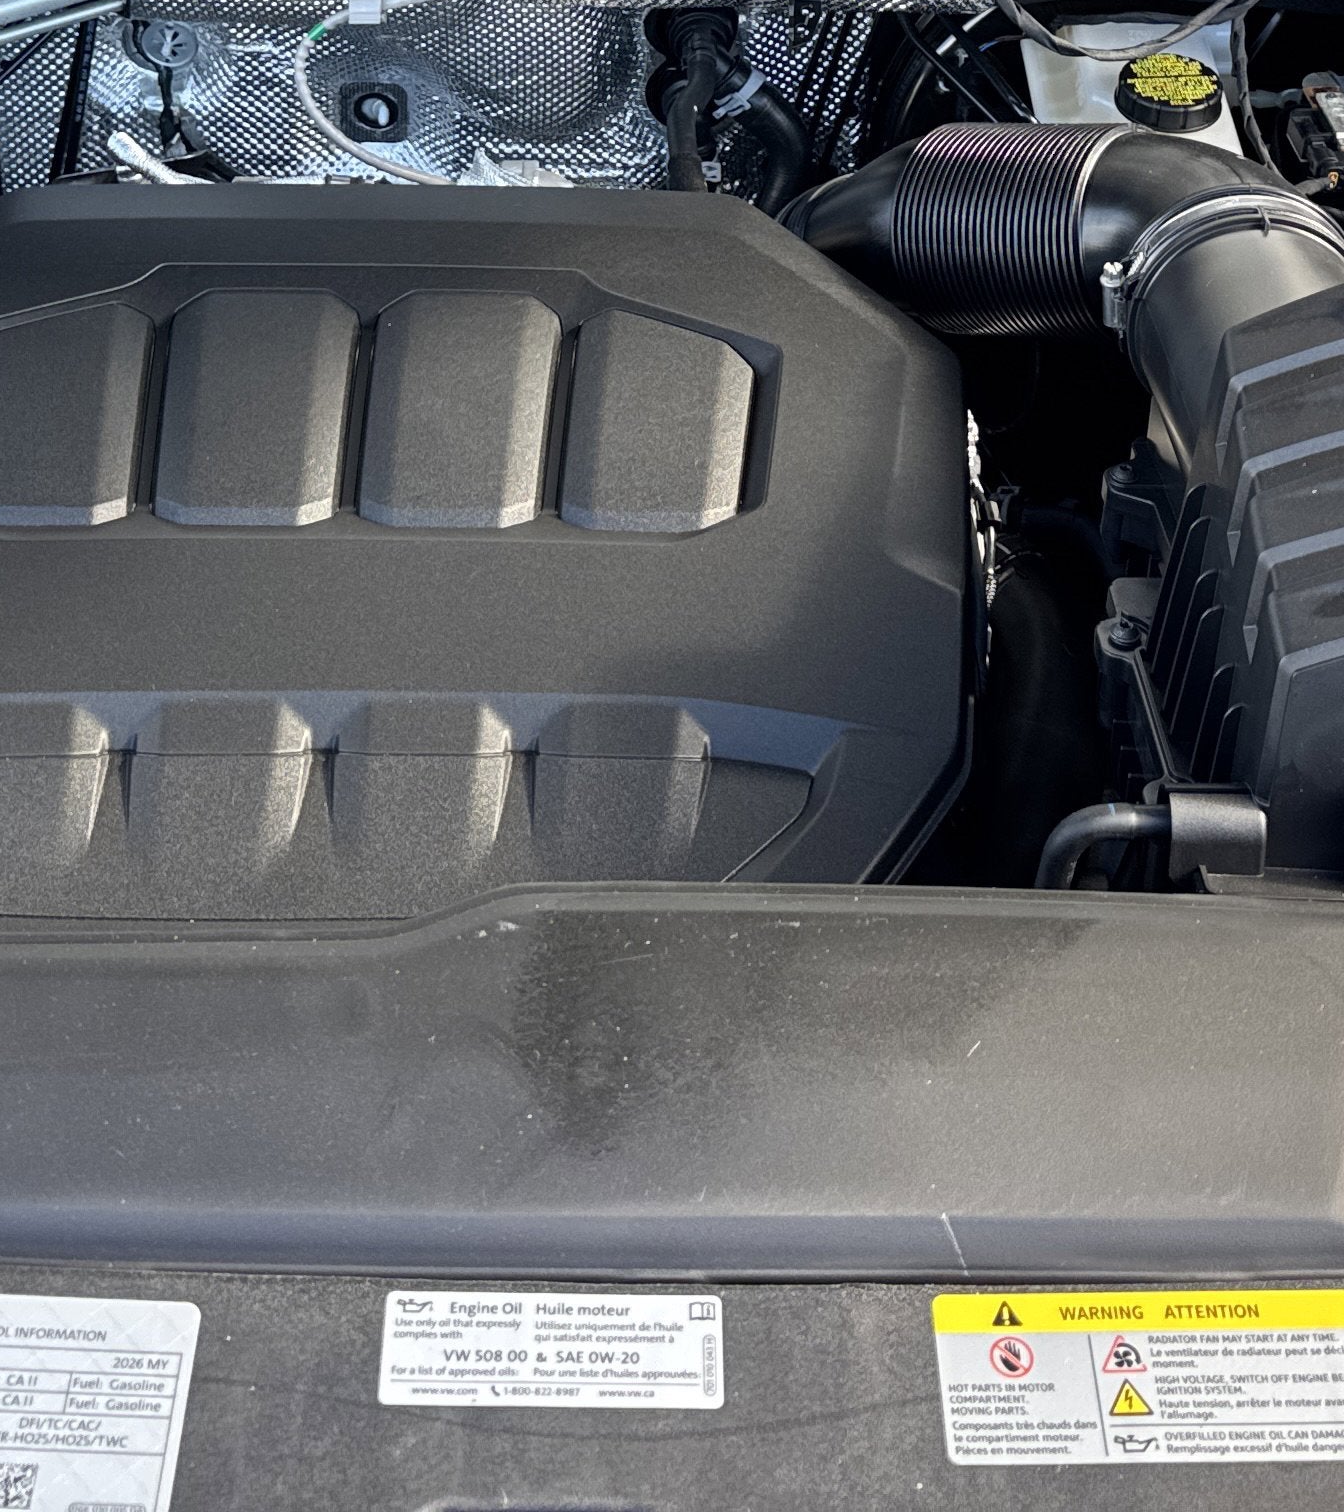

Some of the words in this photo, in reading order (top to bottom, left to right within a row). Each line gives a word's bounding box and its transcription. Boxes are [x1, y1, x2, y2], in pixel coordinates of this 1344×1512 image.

[450, 1301, 498, 1317] Engine
[502, 1302, 522, 1314] Oil
[535, 1303, 573, 1315] Huile
[577, 1304, 630, 1316] moteur
[1059, 1305, 1143, 1320] WARNING
[1164, 1304, 1260, 1319] ATTENTION
[395, 1318, 413, 1327] Use
[416, 1318, 436, 1329] only
[439, 1318, 451, 1327] oil
[453, 1319, 473, 1328] that
[475, 1319, 522, 1331] expressly
[535, 1320, 572, 1330] Utilisez
[574, 1321, 636, 1332] uniquement
[638, 1322, 651, 1331] de
[653, 1322, 684, 1332] l'huile
[15, 1327, 107, 1342] INFORMATION
[393, 1330, 438, 1341] complies
[440, 1330, 463, 1339] with
[534, 1333, 551, 1343] qui
[553, 1333, 593, 1342] satisfait
[595, 1333, 665, 1344] expressément
[669, 1334, 675, 1343] à
[1148, 1335, 1198, 1344] RADIATOR
[1200, 1335, 1219, 1343] FAN
[1222, 1335, 1242, 1343] MAY
[1245, 1334, 1274, 1343] START
[1276, 1334, 1289, 1342] AT
[1290, 1334, 1309, 1342] ANY
[1312, 1333, 1339, 1342] TIME.
[443, 1348, 471, 1362] VW
[475, 1349, 503, 1362] 508
[507, 1349, 528, 1363] 00
[536, 1352, 547, 1363] &
[556, 1351, 584, 1364] SAE
[588, 1351, 640, 1364] 0W-20
[1150, 1348, 1162, 1357] Le
[1164, 1348, 1219, 1356] ventilateur
[1222, 1347, 1234, 1356] de
[1236, 1347, 1282, 1356] radiateur
[1285, 1346, 1308, 1357] peut
[1310, 1347, 1322, 1355] se
[112, 1357, 144, 1369] 2026
[147, 1358, 169, 1370] MY
[1152, 1360, 1198, 1368] moment.
[391, 1365, 406, 1376] For
[418, 1366, 432, 1376] list
[436, 1366, 447, 1376] of
[448, 1367, 496, 1378] approved
[498, 1367, 519, 1376] oils:
[533, 1368, 555, 1377] Pour
[558, 1369, 576, 1377] une
[579, 1368, 599, 1378] liste
[601, 1369, 639, 1378] d'huiles
[6, 1374, 26, 1386] CA
[73, 1377, 103, 1389] Fuel:
[109, 1379, 165, 1392] Gasoline
[1155, 1375, 1180, 1384] HIGH
[1230, 1375, 1268, 1383] SWITCH
[1270, 1374, 1289, 1383] OFF
[1292, 1373, 1328, 1382] ENGINE
[412, 1387, 478, 1395] www.vw.com
[598, 1390, 655, 1398] www.vw.ca
[948, 1384, 969, 1392] HOT
[971, 1384, 1003, 1392] PARTS
[1005, 1384, 1016, 1392] IN
[1018, 1383, 1055, 1392] MOTOR
[1156, 1386, 1202, 1395] IGNITION
[1204, 1386, 1246, 1395] SYSTEM.
[1, 1394, 21, 1406] CA
[68, 1397, 99, 1410] Fuel:
[105, 1398, 161, 1412] Gasoline
[949, 1395, 1030, 1404] COMPARTMENT.
[1159, 1399, 1190, 1408] Haute
[1193, 1399, 1234, 1409] tension,
[1236, 1397, 1271, 1407] arrêter
[1273, 1398, 1282, 1407] le
[1284, 1397, 1322, 1407] moteur
[951, 1407, 992, 1415] MOVING
[995, 1406, 1029, 1415] PARTS.
[18, 1417, 102, 1432] DFI/TC/CAC/
[952, 1421, 1014, 1432] Composants
[1016, 1420, 1035, 1430] très
[1036, 1420, 1072, 1429] chauds
[1074, 1420, 1098, 1429] dans
[954, 1434, 963, 1442] le
[966, 1433, 1039, 1445] compartiment
[1042, 1434, 1084, 1442] moteur.
[1165, 1431, 1226, 1441] OVERFILLED
[1228, 1431, 1266, 1440] ENGINE
[1268, 1431, 1284, 1440] OIL
[1287, 1430, 1309, 1439] CAN
[955, 1446, 988, 1455] Pièces
[1006, 1446, 1072, 1455] mouvement.
[1167, 1444, 1231, 1455] Remplissage
[1233, 1443, 1272, 1453] excessif
[1275, 1443, 1309, 1452] d'huile
